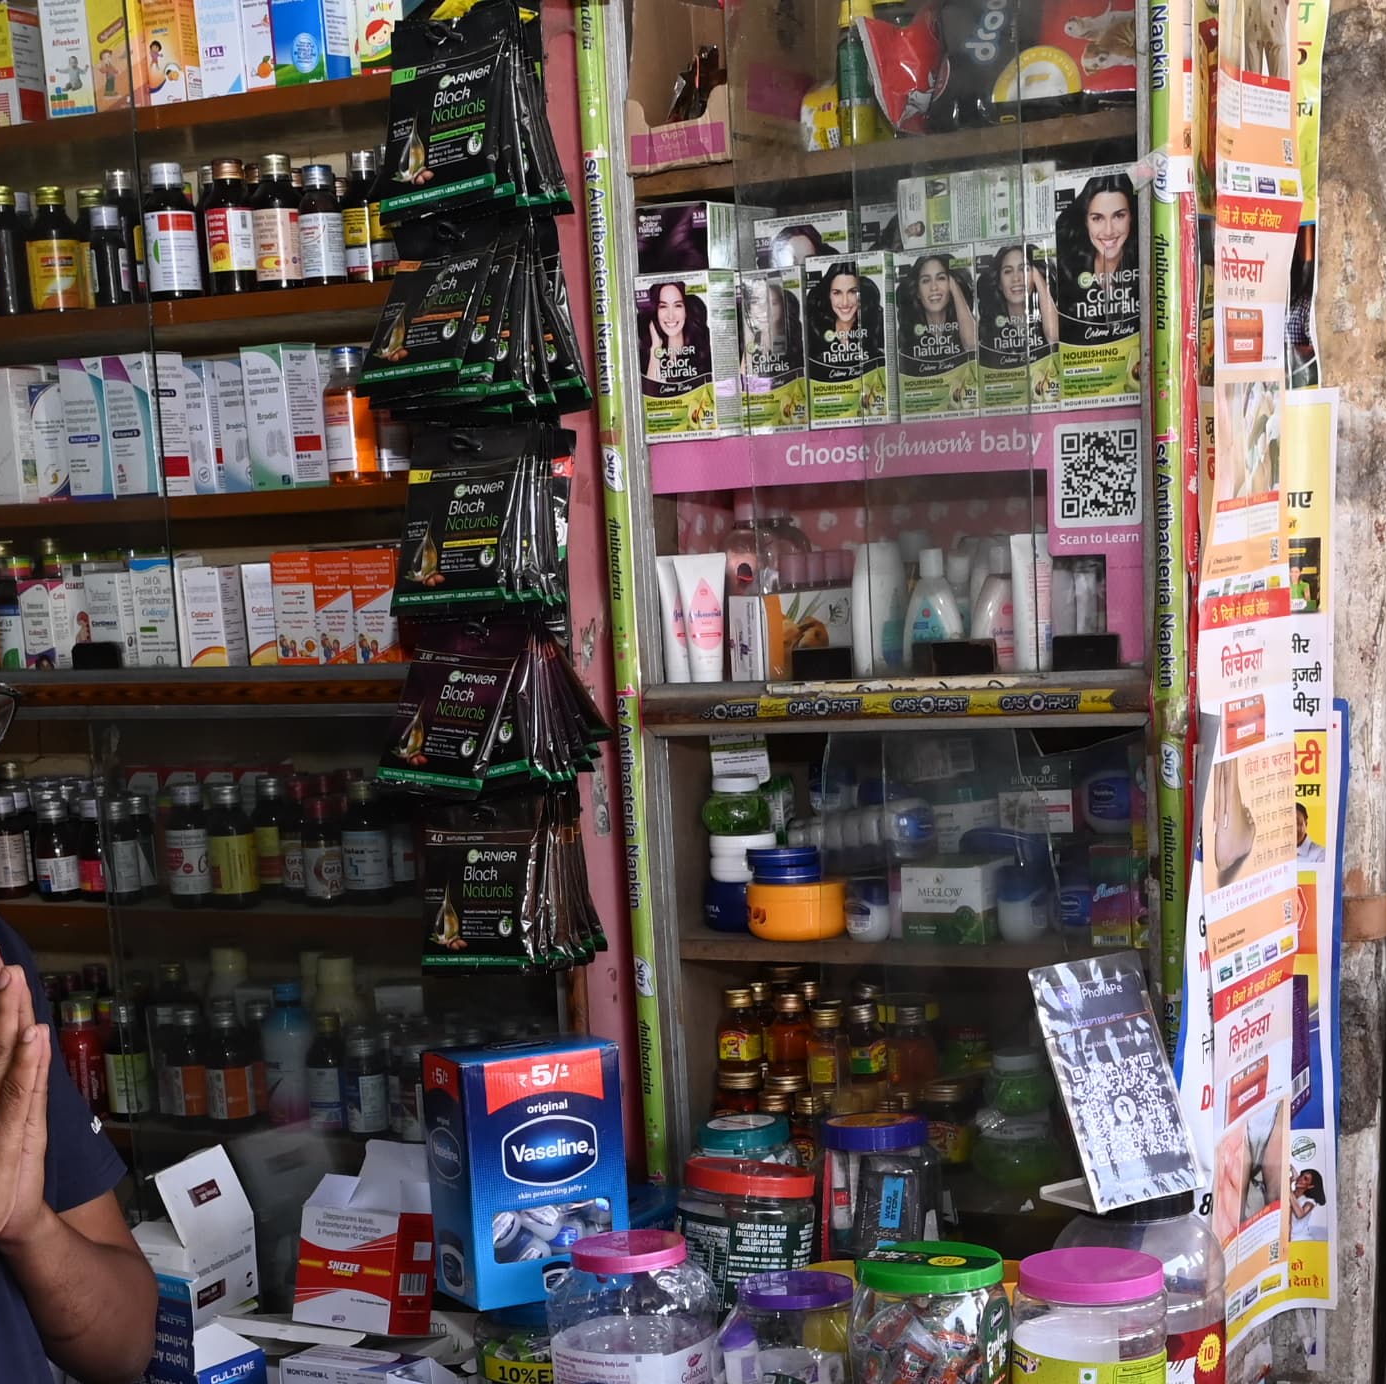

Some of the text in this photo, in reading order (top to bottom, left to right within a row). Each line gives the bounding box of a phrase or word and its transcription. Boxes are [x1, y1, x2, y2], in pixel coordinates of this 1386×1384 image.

[1148, 4, 1170, 90] Napkin
[438, 64, 492, 89] GARNIER
[433, 86, 472, 108] Black
[430, 98, 486, 126] Naturals
[581, 146, 617, 396] 1st Antibacteria Napkin
[1221, 246, 1265, 284] लिचेन्सा
[1154, 233, 1171, 331] Antibacteria
[1086, 286, 1132, 303] Color
[1077, 298, 1140, 318] Naturals
[914, 322, 959, 337] GARNIER
[1001, 326, 1035, 340] Color
[920, 334, 951, 347] Color
[994, 336, 1044, 349] Naturals
[654, 345, 696, 359] GARNIER
[823, 350, 870, 364] Naturals
[830, 342, 862, 356] Color
[913, 345, 961, 358] Naturals
[1063, 348, 1119, 361] NOURISHING
[659, 357, 690, 370] Color
[752, 353, 781, 366] Color
[1064, 399, 1101, 407] NOURISHED
[785, 428, 1042, 473] Choose Johnson's baby
[454, 480, 505, 498] GARNIER
[448, 498, 485, 516] Black
[445, 513, 499, 532] Naturals
[1059, 530, 1140, 545] Scan to Learn
[608, 517, 625, 600] Antibacteria
[1153, 427, 1179, 690] 1st Antibacteria Napkin
[1212, 606, 1219, 623] 3
[448, 670, 498, 686] GARNIER
[440, 685, 475, 703] Black
[435, 701, 486, 721] Naturals
[612, 682, 644, 909] 1st Antibacteria Napkin
[431, 834, 443, 843] 4.0
[467, 849, 518, 864] GARNIER
[1162, 816, 1181, 902] Antibacteria
[463, 865, 498, 881] Black
[462, 883, 513, 898] Naturals
[917, 885, 963, 898] MEGLOW
[1080, 984, 1123, 1000] PhonePe
[1226, 995, 1232, 1011] 3
[1228, 1011, 1273, 1057] लिचेन्सा
[638, 1019, 655, 1095] Antibacteria
[526, 1098, 569, 1115] original
[511, 1138, 589, 1163] Vaseline
[517, 1184, 583, 1200] skin protecting jelly
[884, 1195, 893, 1220] WILD
[736, 1222, 776, 1232] FIGARO OLIVE OIL
[735, 1231, 788, 1240] EXCELLENT ALL PURPOSE
[736, 1245, 760, 1253] GOODNESS
[768, 1246, 783, 1254] OLIVES
[211, 1360, 255, 1384] GULZYME
[286, 1367, 329, 1380] MONTICHEM-L
